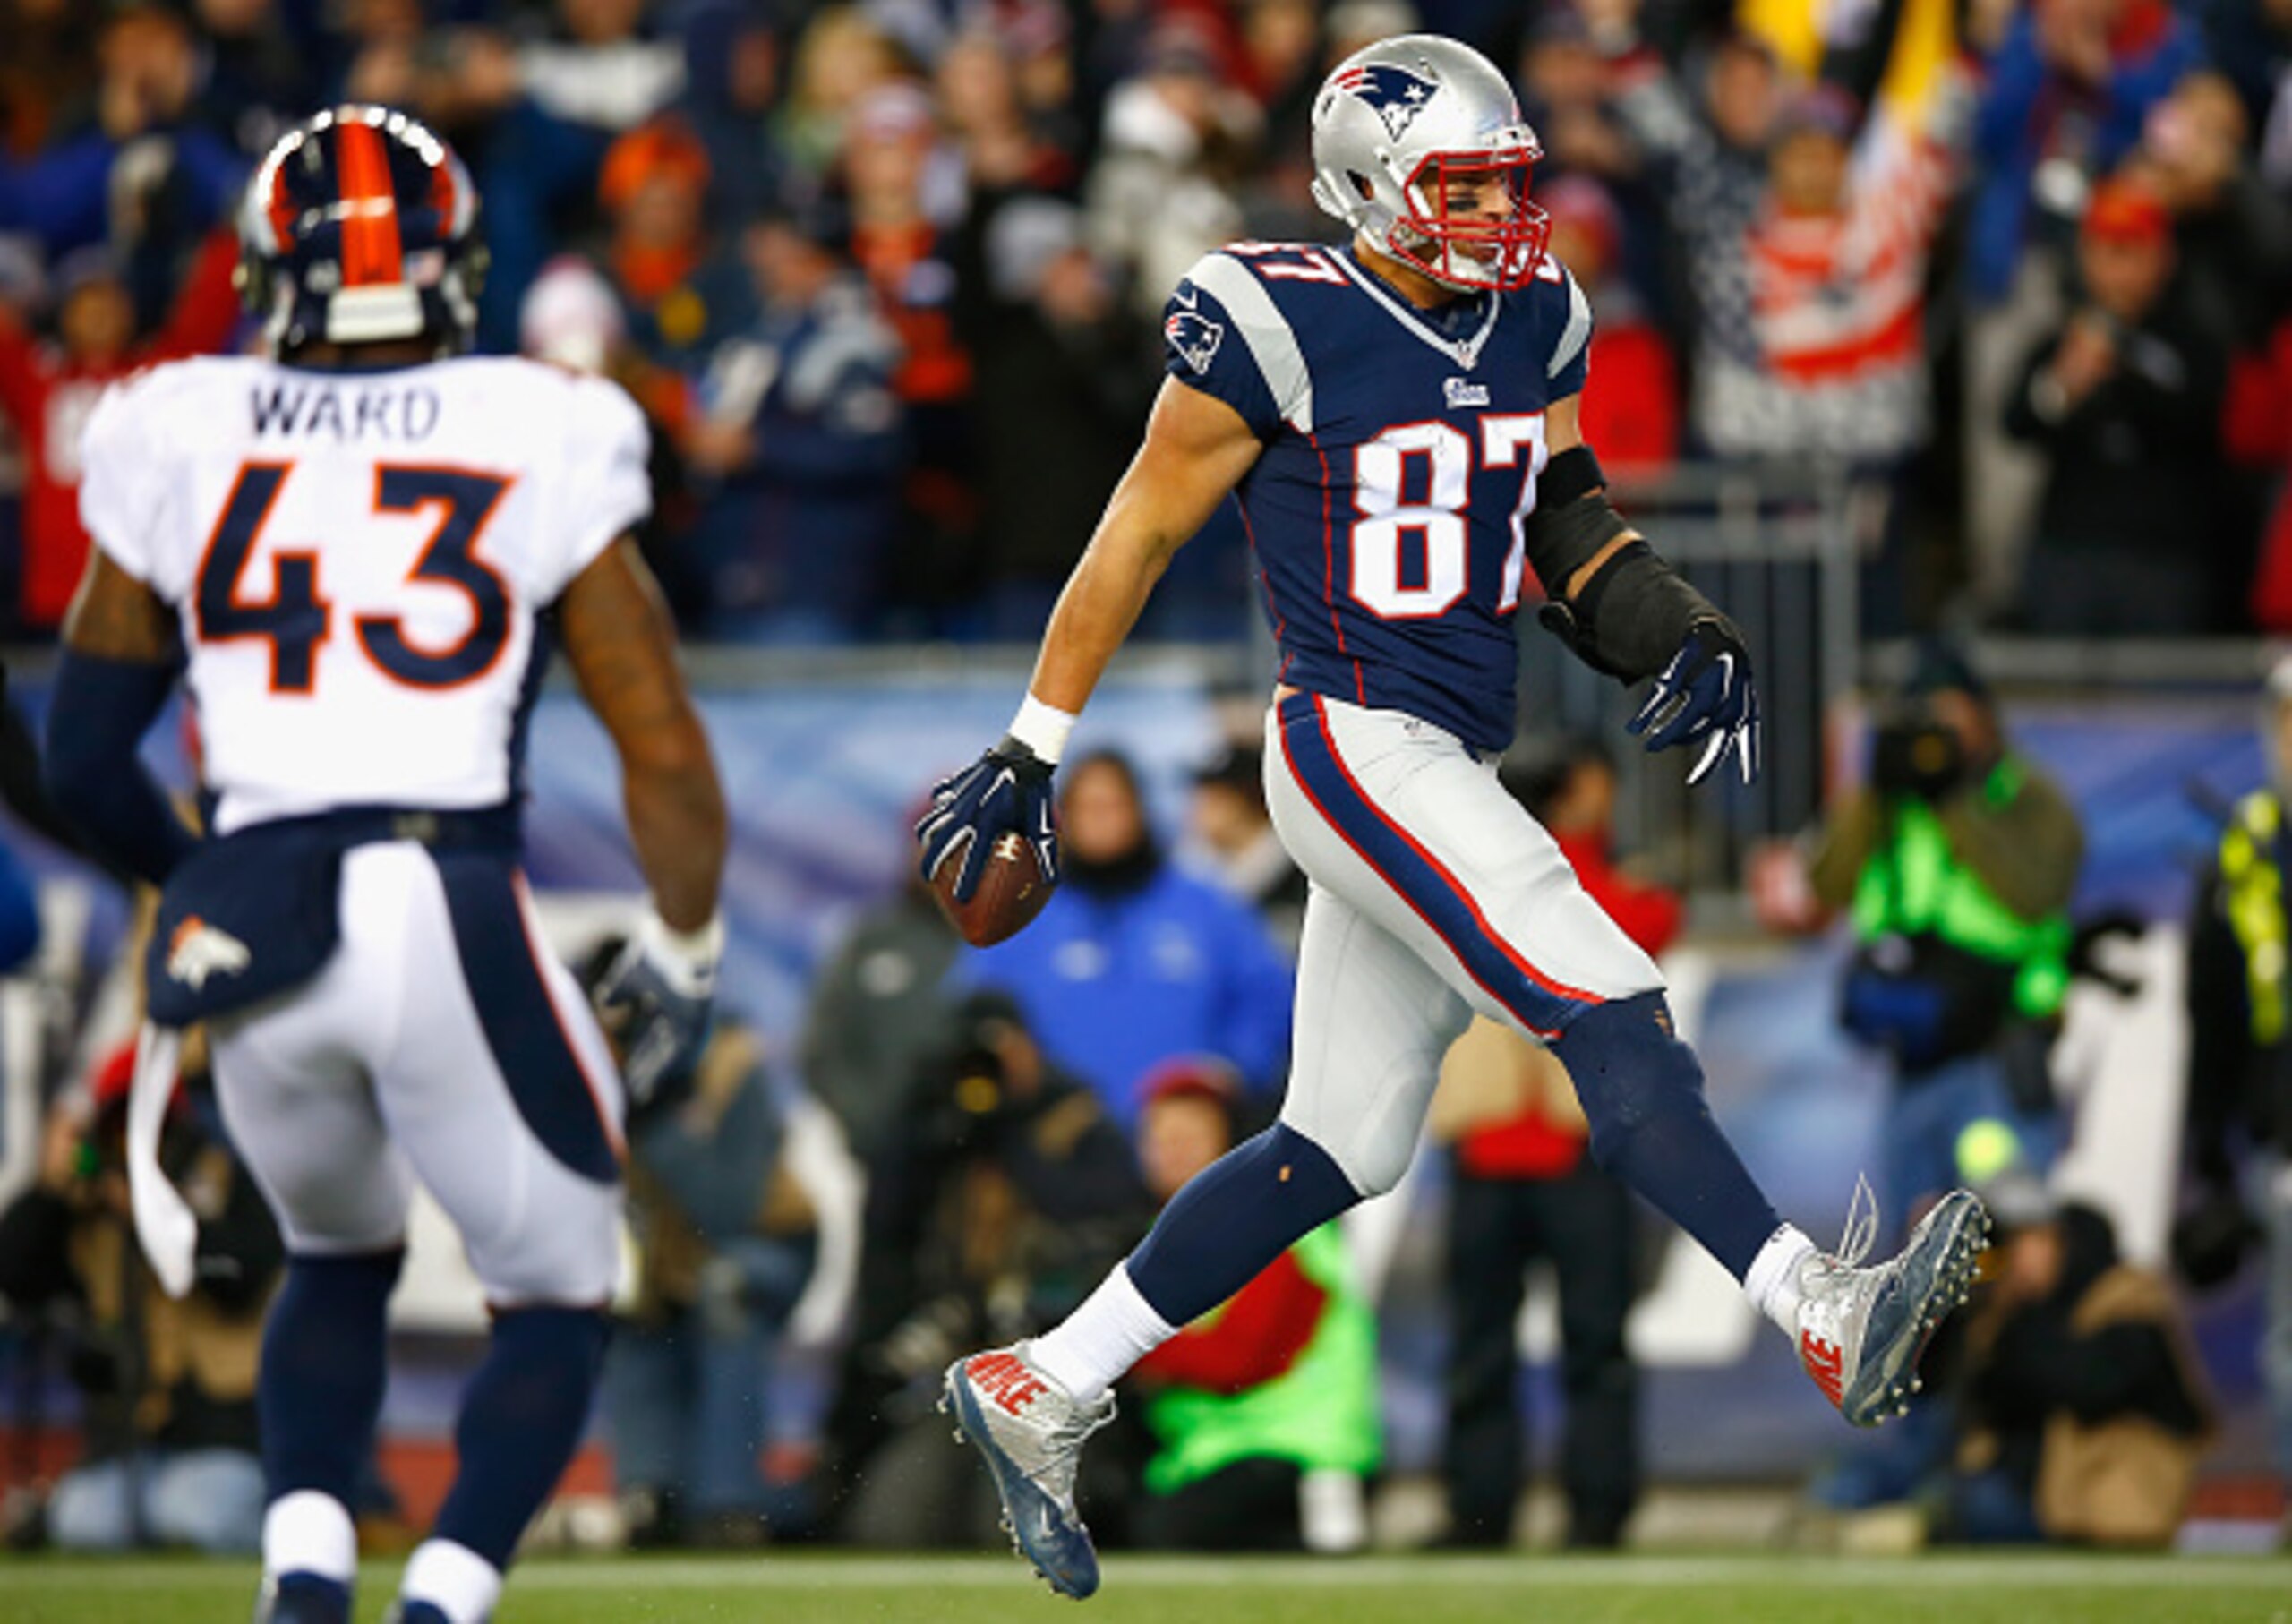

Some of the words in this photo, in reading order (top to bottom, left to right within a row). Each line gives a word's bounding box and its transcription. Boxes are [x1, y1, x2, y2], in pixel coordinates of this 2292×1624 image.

[252, 385, 440, 442] WARD
[194, 458, 521, 697] 43
[1347, 408, 1548, 620] 87
[965, 1353, 1049, 1416] NIKE
